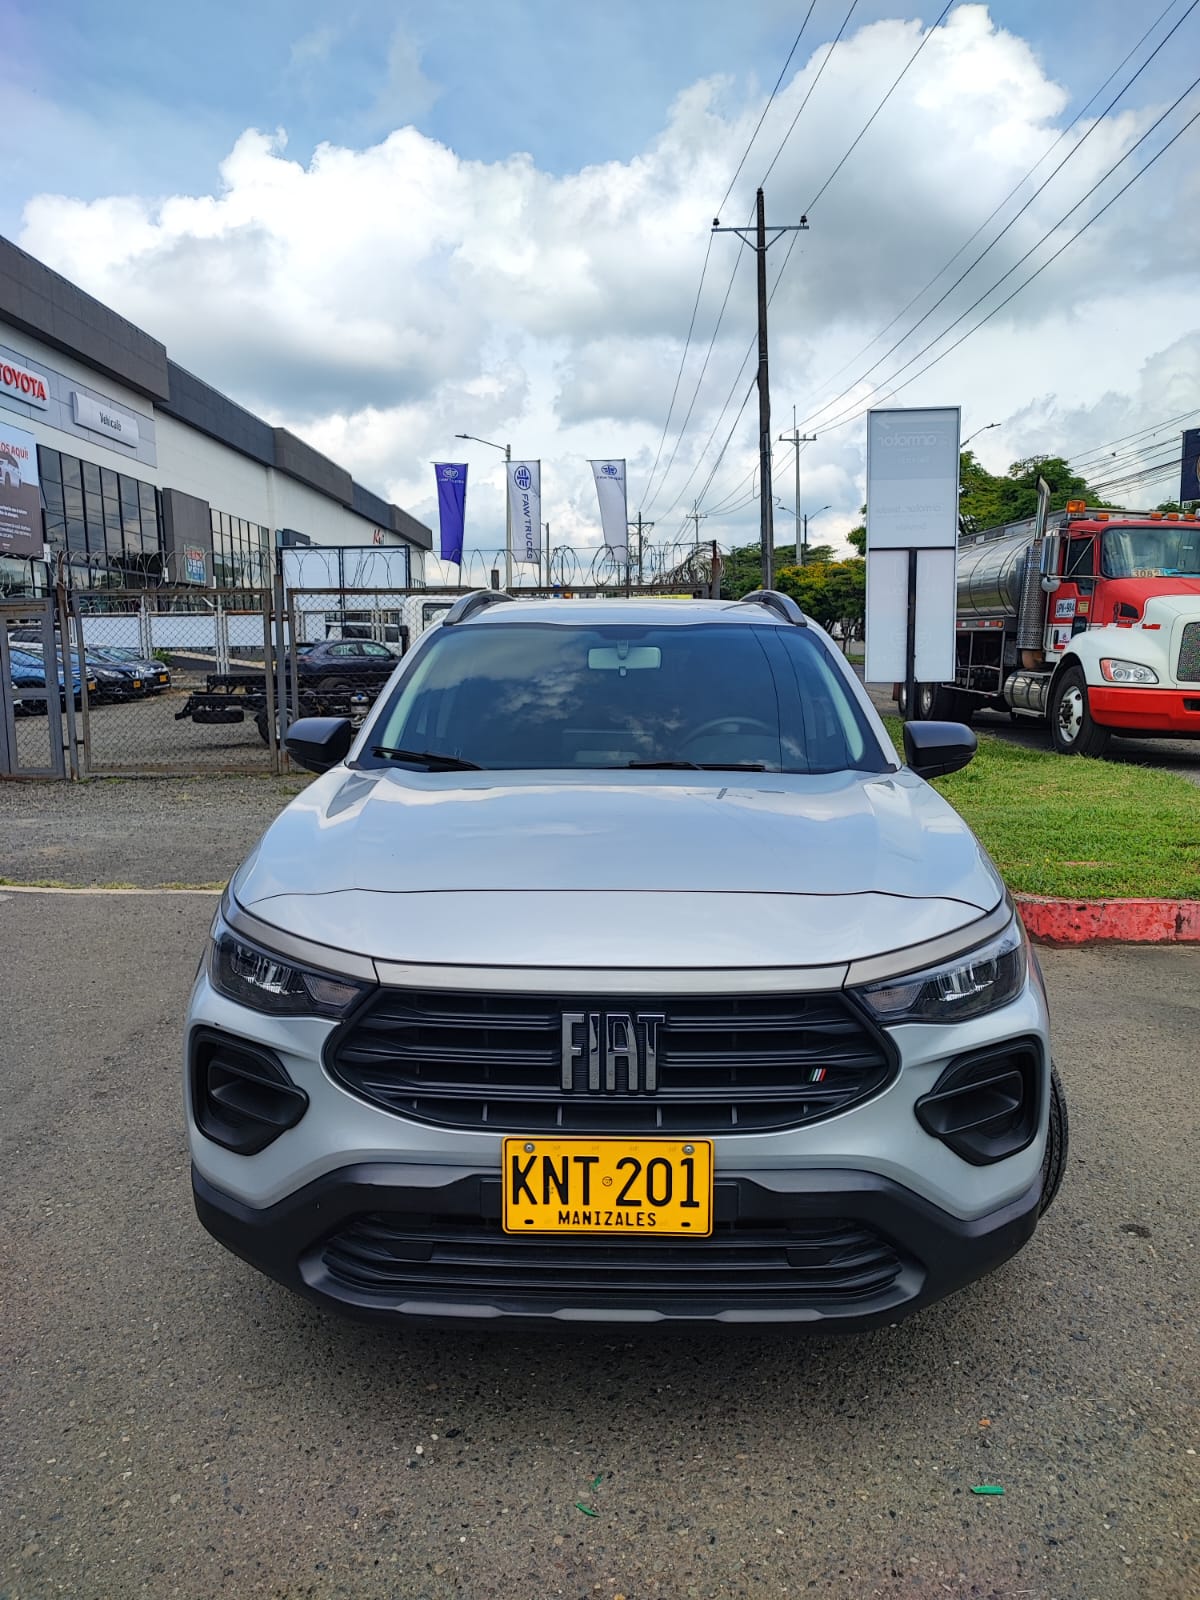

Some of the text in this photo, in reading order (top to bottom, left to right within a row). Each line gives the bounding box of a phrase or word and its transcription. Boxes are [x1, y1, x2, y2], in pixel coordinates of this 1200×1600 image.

[561, 1012, 666, 1092] FIAT
[511, 1155, 700, 1208] KNT 201
[558, 1210, 657, 1227] MANIZALES
